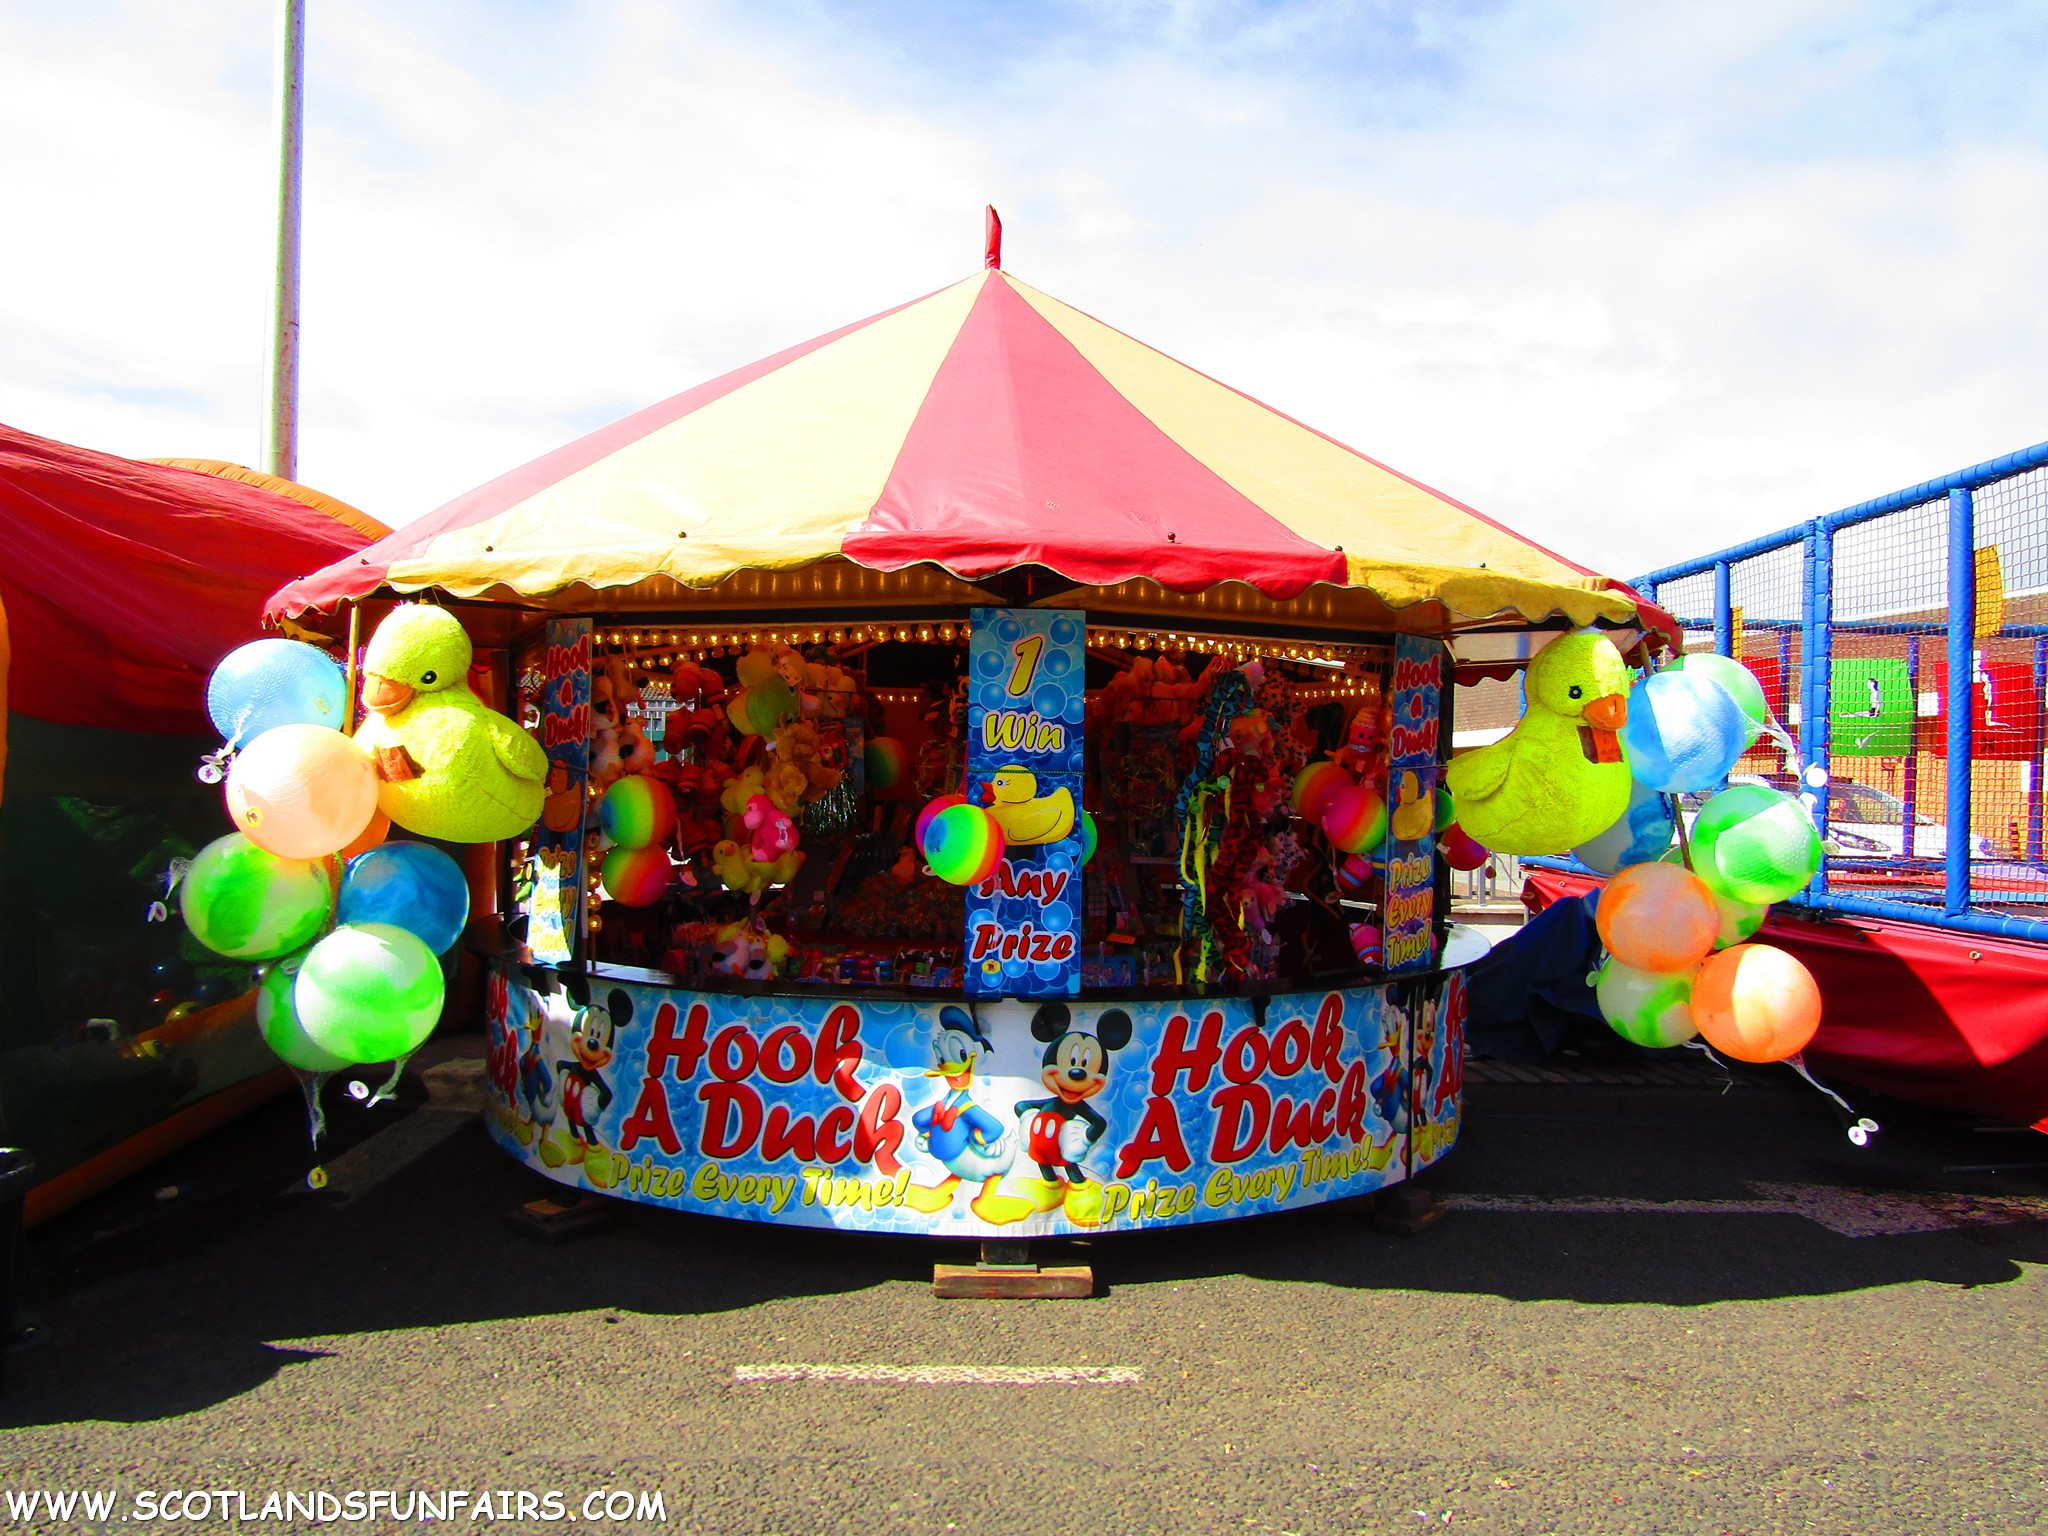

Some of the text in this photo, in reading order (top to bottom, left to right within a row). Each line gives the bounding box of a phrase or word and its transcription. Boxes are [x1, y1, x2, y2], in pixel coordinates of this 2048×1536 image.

[547, 634, 590, 681] Hook
[1008, 636, 1042, 697] 1
[1396, 655, 1440, 692] Hook
[544, 703, 589, 747] Duck!
[985, 713, 1062, 750] Win
[1391, 718, 1438, 758] Duck!
[980, 861, 1067, 906] Any
[1390, 854, 1431, 893] Prize
[1388, 889, 1432, 929] Every
[972, 923, 1073, 960] Prize
[1387, 920, 1431, 968] Time!
[647, 1003, 866, 1102] Hook
[1151, 993, 1345, 1098] Hook
[620, 1077, 905, 1177] A Duck
[1116, 1060, 1367, 1179] A Duck
[608, 1153, 911, 1214] Prize Every Time!
[1102, 1134, 1372, 1223] Prize Every Time!
